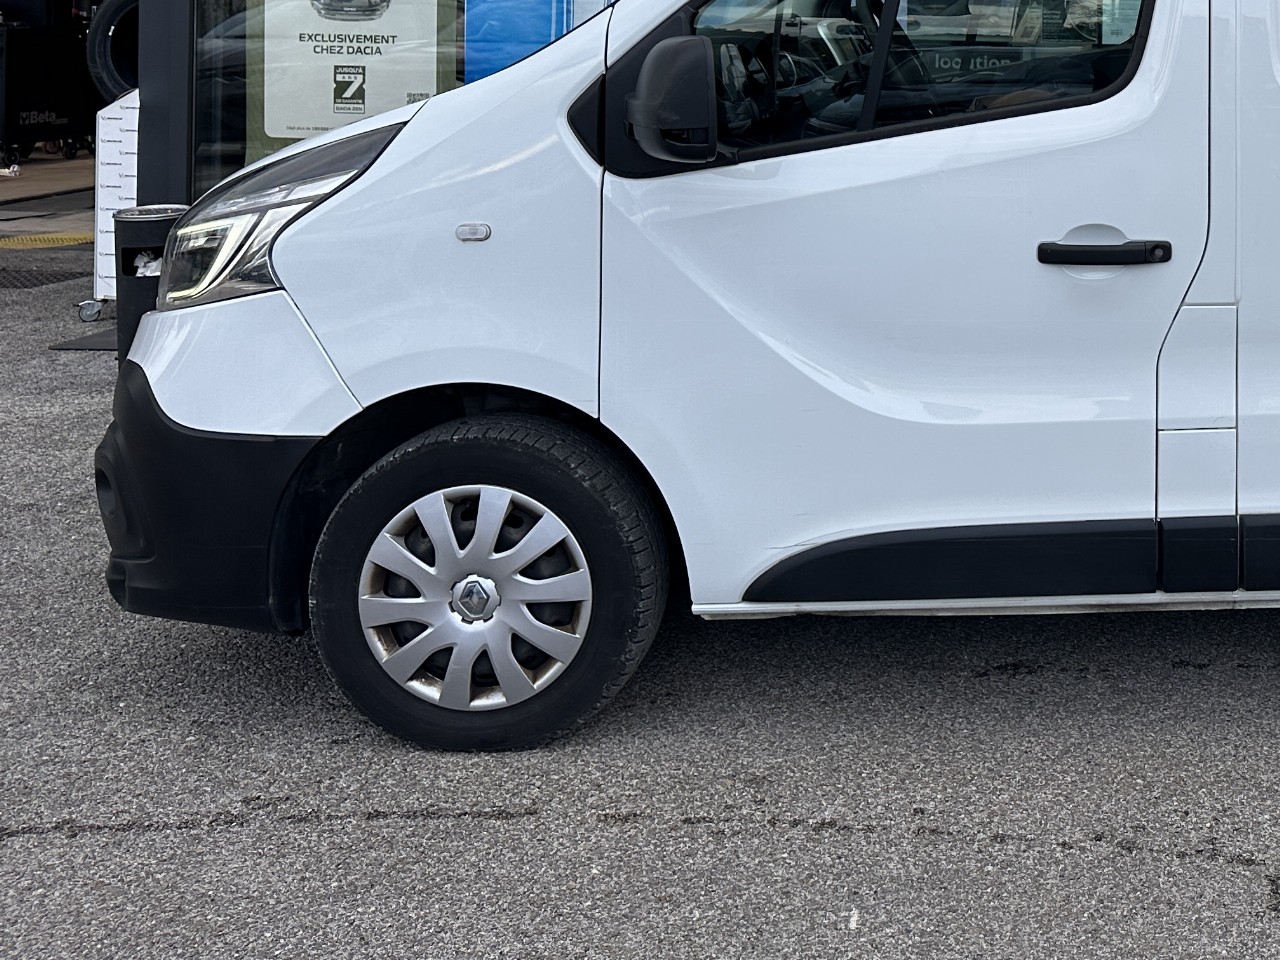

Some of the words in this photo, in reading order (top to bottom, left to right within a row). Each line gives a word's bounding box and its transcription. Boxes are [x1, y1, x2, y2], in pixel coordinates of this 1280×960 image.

[298, 32, 398, 45] EXCLUSIVEMENT
[313, 44, 344, 54] CHEZ
[346, 45, 383, 56] DACIA
[30, 110, 56, 124] Beta
